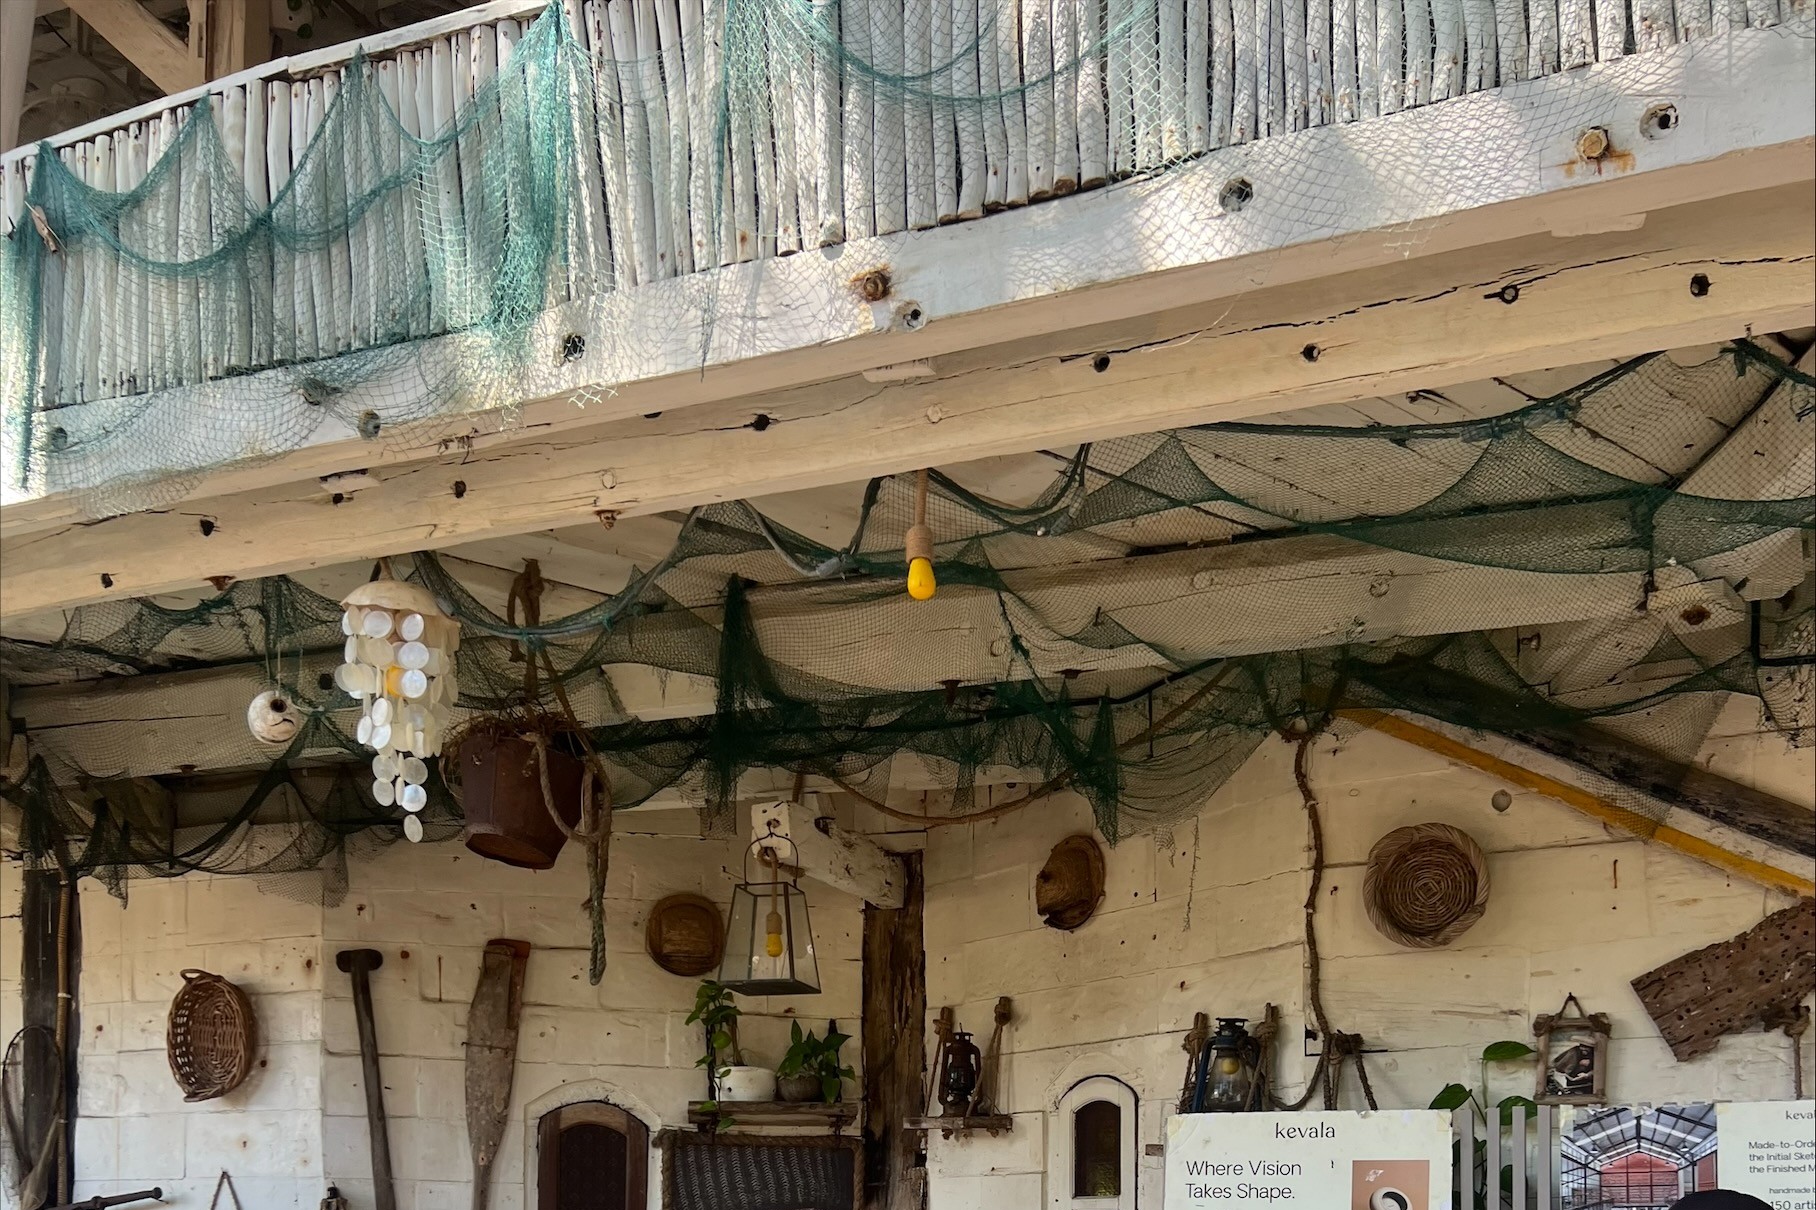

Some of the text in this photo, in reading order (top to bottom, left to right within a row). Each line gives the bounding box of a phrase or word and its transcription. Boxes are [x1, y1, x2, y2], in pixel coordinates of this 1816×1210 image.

[1275, 1121, 1336, 1139] kevala
[1749, 1153, 1765, 1161] the
[1766, 1152, 1791, 1161] Initial
[1186, 1160, 1302, 1176] Where Vision
[1749, 1165, 1765, 1173] the
[1766, 1163, 1806, 1173] Finished
[1185, 1182, 1295, 1203] Takes Shape.
